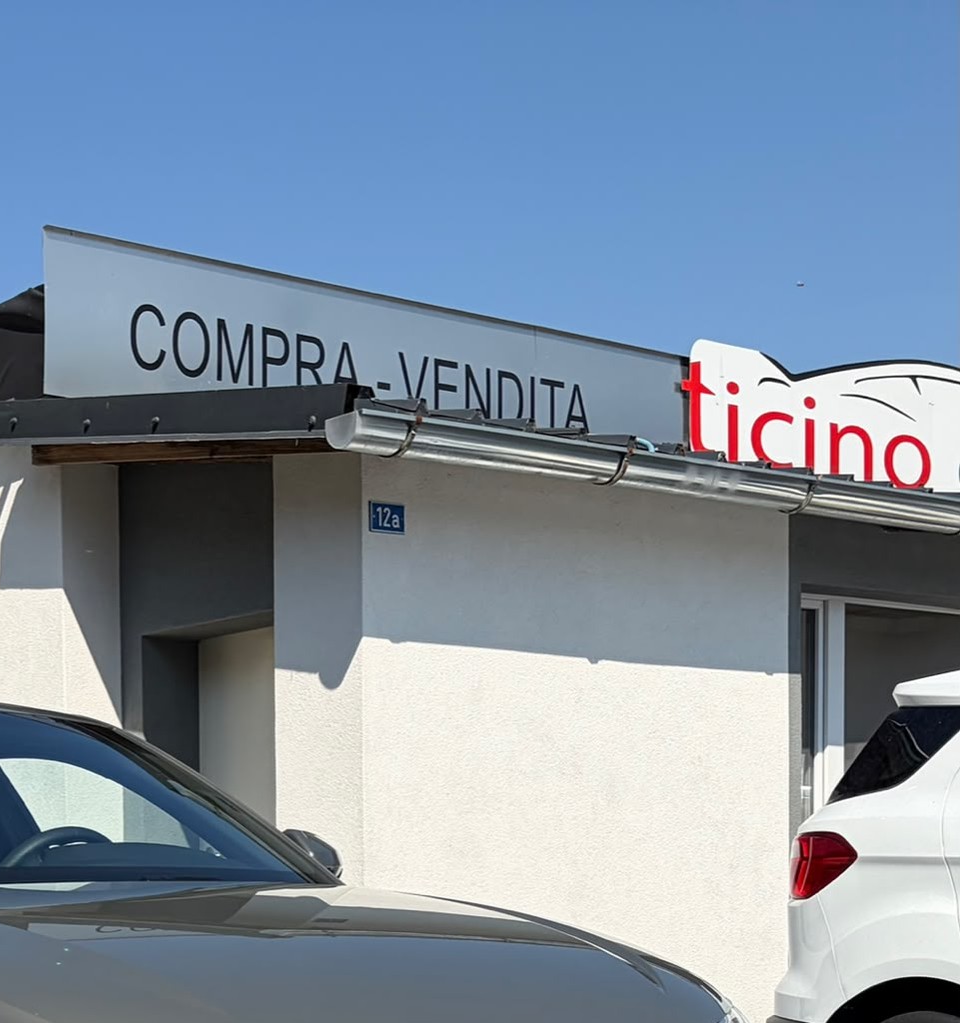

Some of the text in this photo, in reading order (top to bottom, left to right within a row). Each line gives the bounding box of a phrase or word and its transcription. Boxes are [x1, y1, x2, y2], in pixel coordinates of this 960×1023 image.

[130, 304, 590, 434] COMPRA - VENDITA
[681, 361, 932, 490] ticino
[376, 506, 401, 529] 12a
